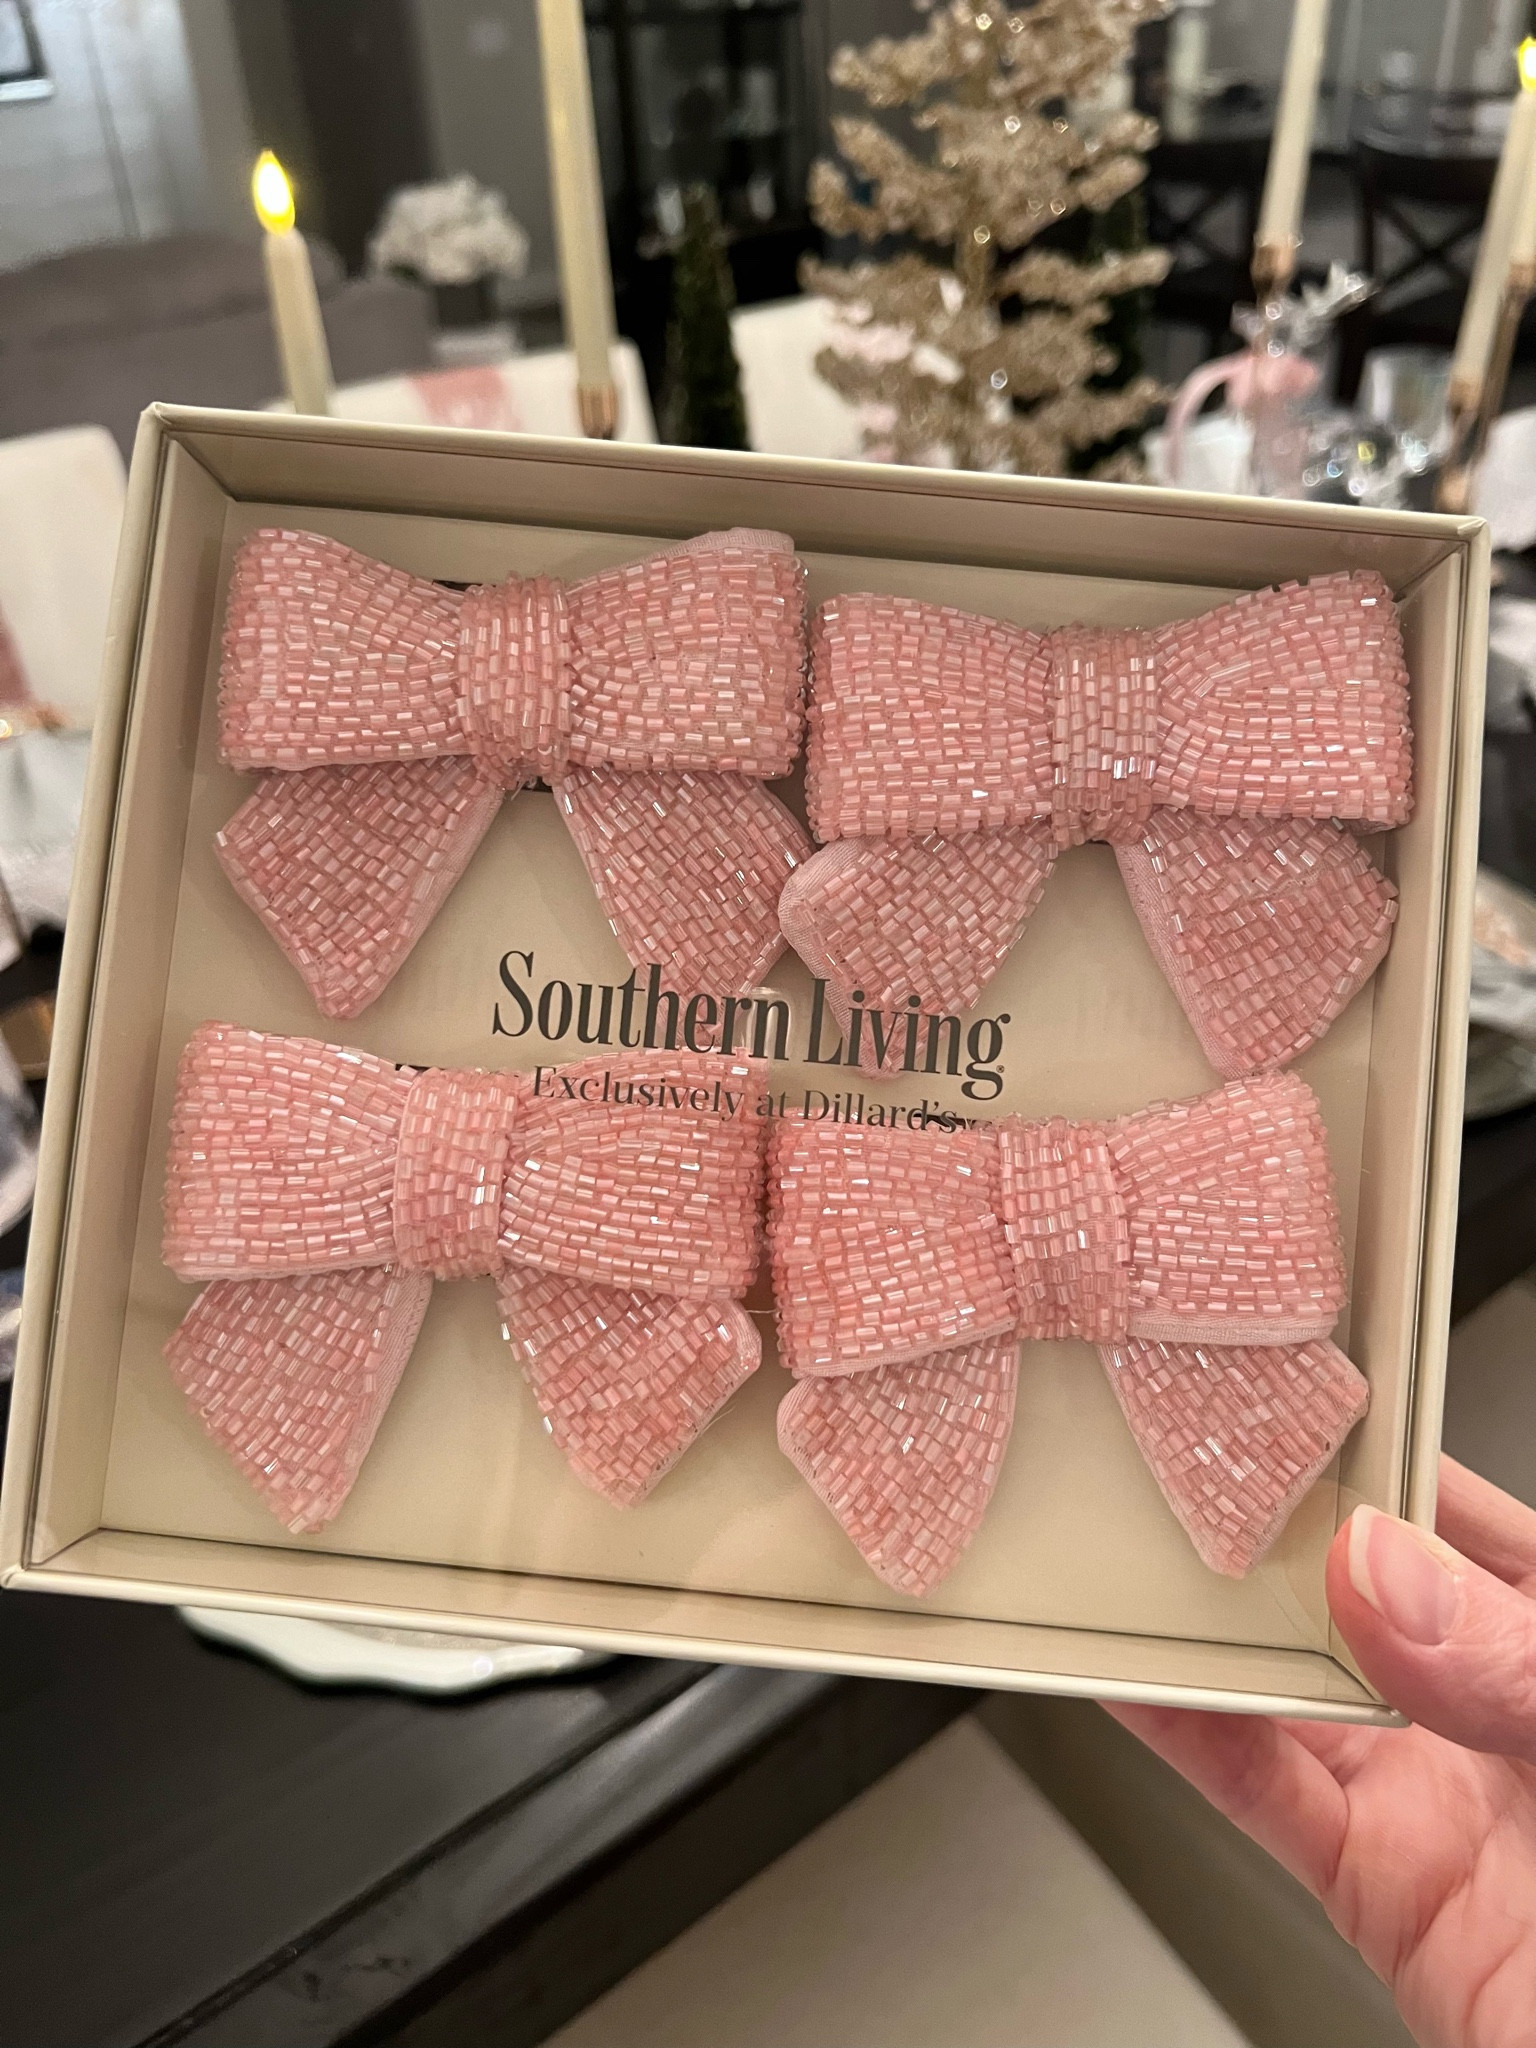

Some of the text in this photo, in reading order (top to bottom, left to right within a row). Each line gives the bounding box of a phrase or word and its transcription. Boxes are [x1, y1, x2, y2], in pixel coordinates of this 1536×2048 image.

[491, 950, 791, 1062] Southern
[533, 1065, 959, 1134] Exclusively at Dillard's
